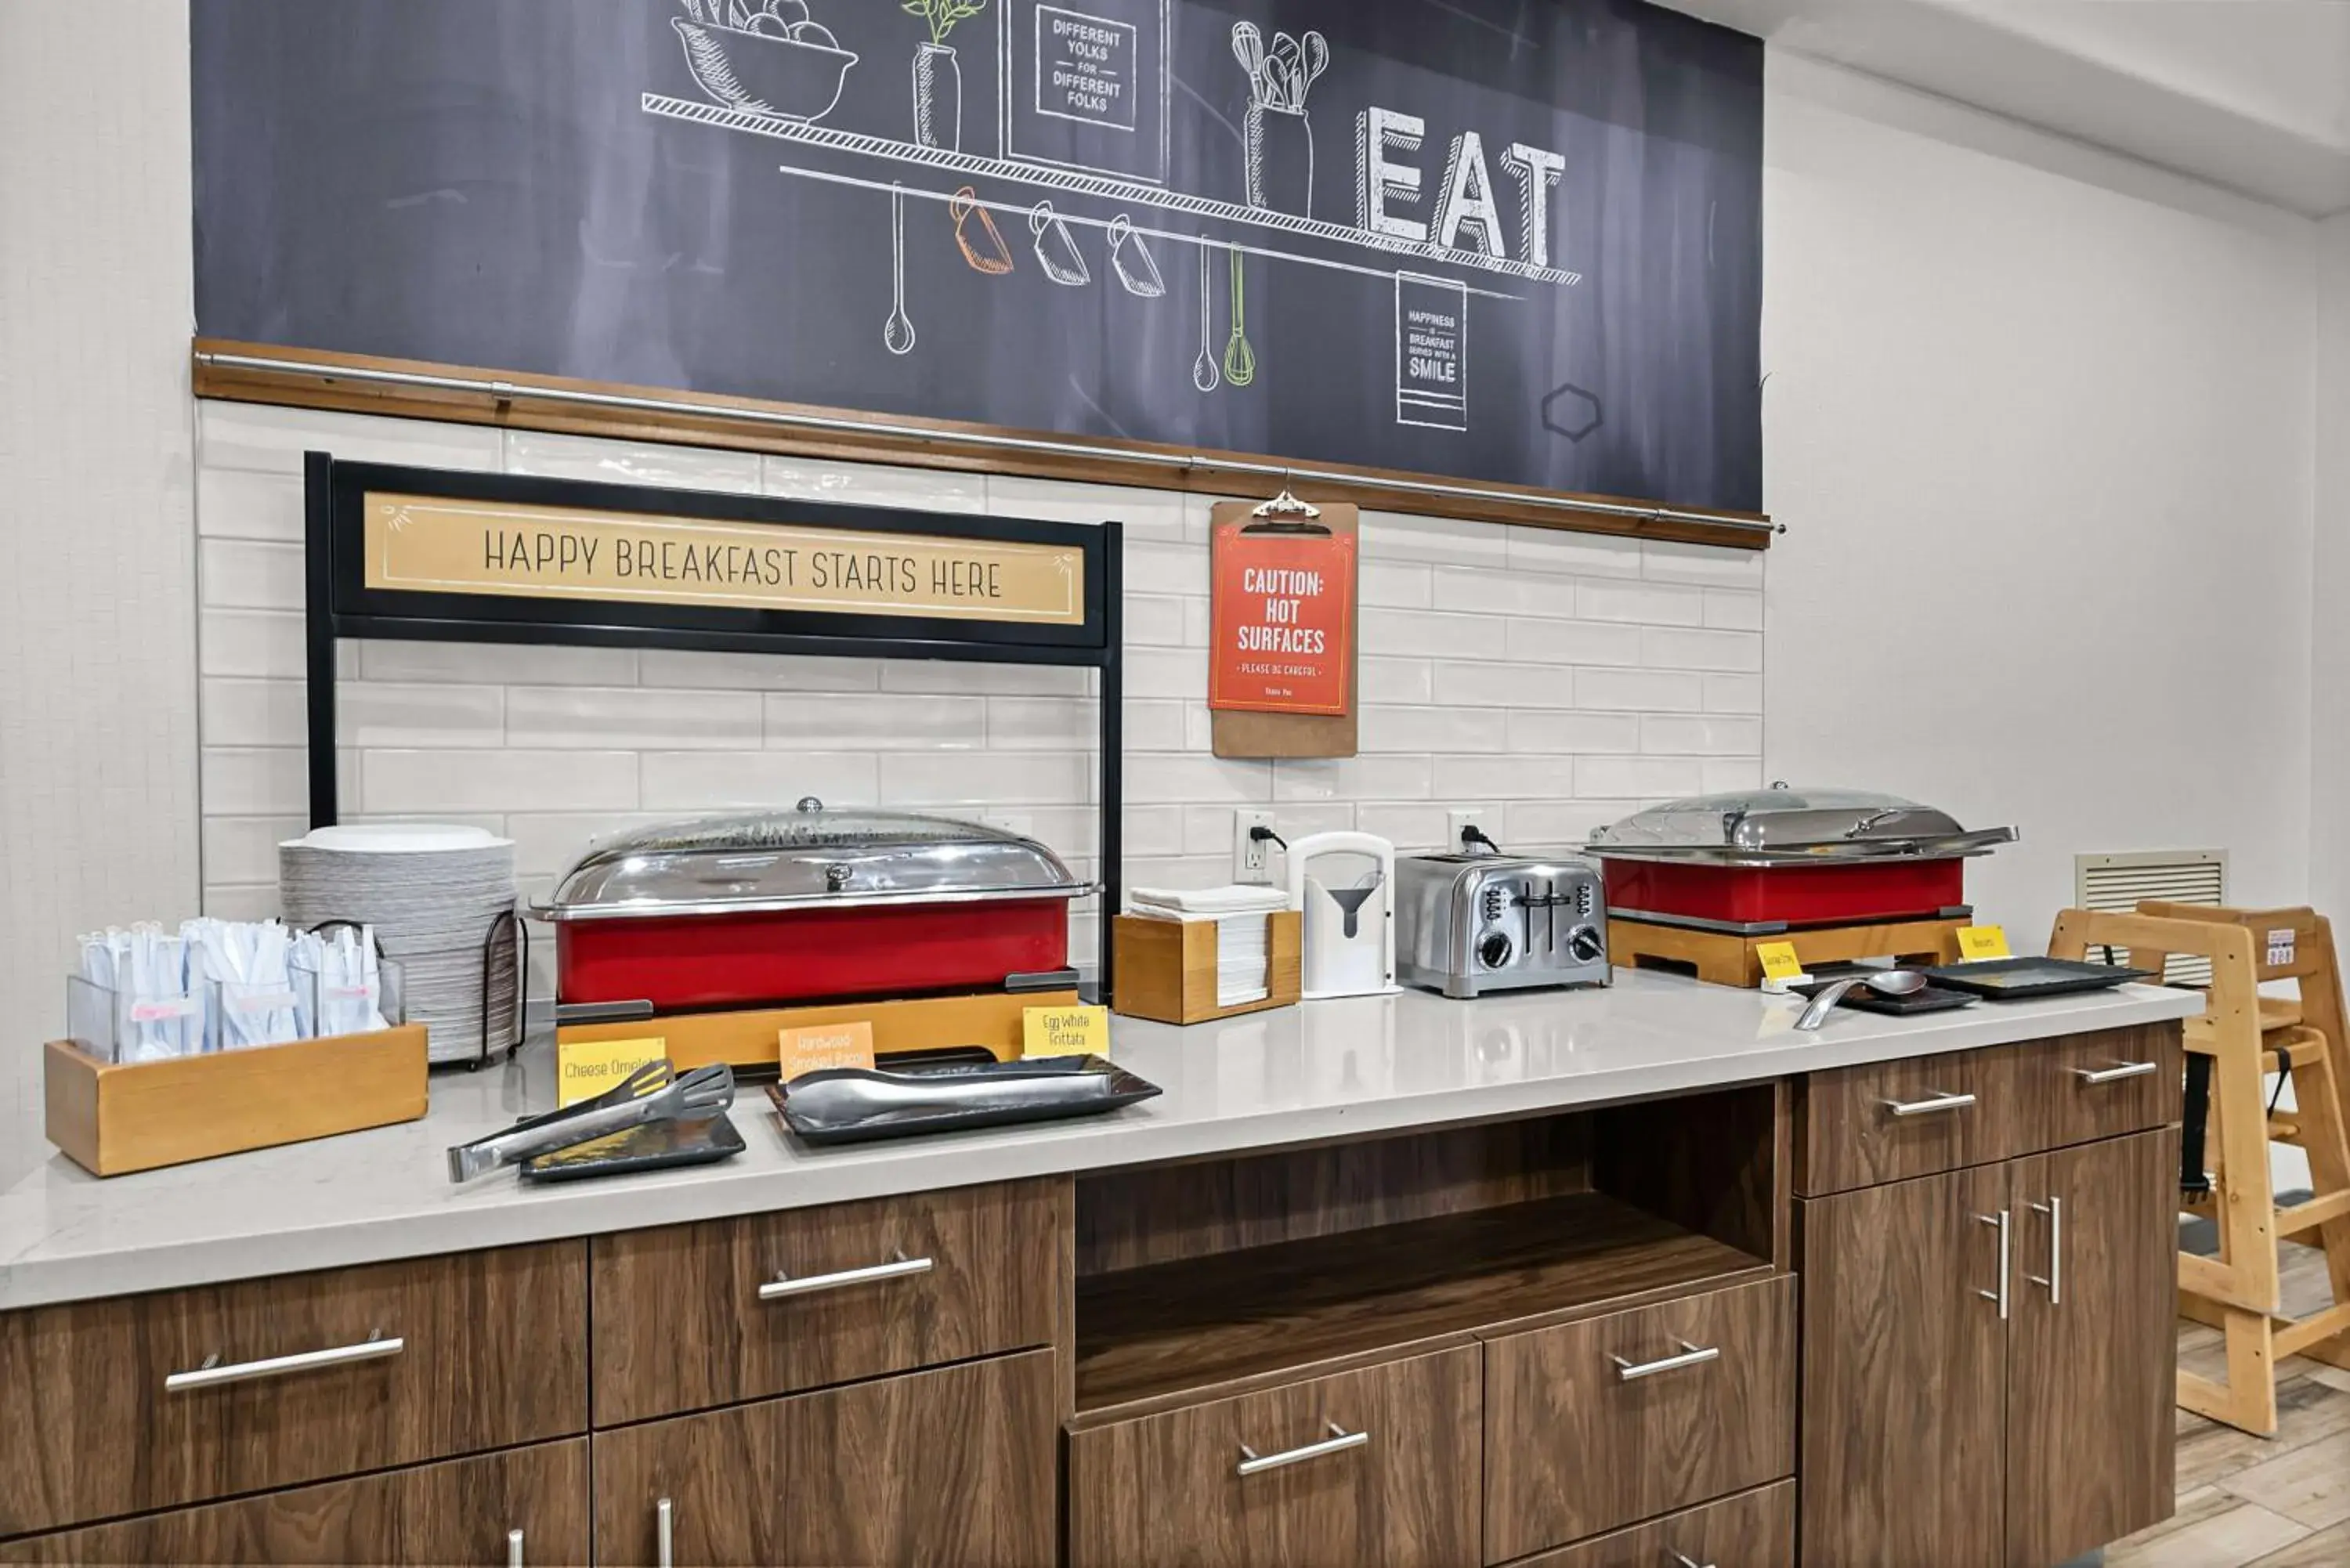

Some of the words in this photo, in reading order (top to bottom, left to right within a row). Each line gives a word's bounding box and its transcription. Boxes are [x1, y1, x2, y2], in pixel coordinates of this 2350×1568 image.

[1053, 19, 1120, 46] DIFFERENT
[1067, 40, 1108, 61] YOLKS
[1077, 62, 1097, 75] FOR
[1053, 70, 1121, 98] DIFFERENT
[1068, 91, 1107, 112] FOLKS
[1356, 106, 1566, 267] EAT
[1408, 310, 1455, 327] HAPPINESS
[1409, 332, 1455, 350] BREAKFAST
[1409, 356, 1457, 383] SMILE
[484, 529, 598, 575] HAPPY
[616, 538, 797, 586] BREAKFAST
[812, 551, 916, 593] STARTS
[931, 559, 1002, 598] HERE
[1244, 568, 1324, 595] CAUTION:
[1266, 598, 1300, 624] HOT
[1238, 626, 1325, 654] SURFACES
[1241, 663, 1270, 675] PLEASE
[1284, 664, 1318, 677] CAREFUL
[1043, 1015, 1060, 1031] Egg
[1061, 1013, 1090, 1028] White
[564, 1061, 608, 1078] Cheese
